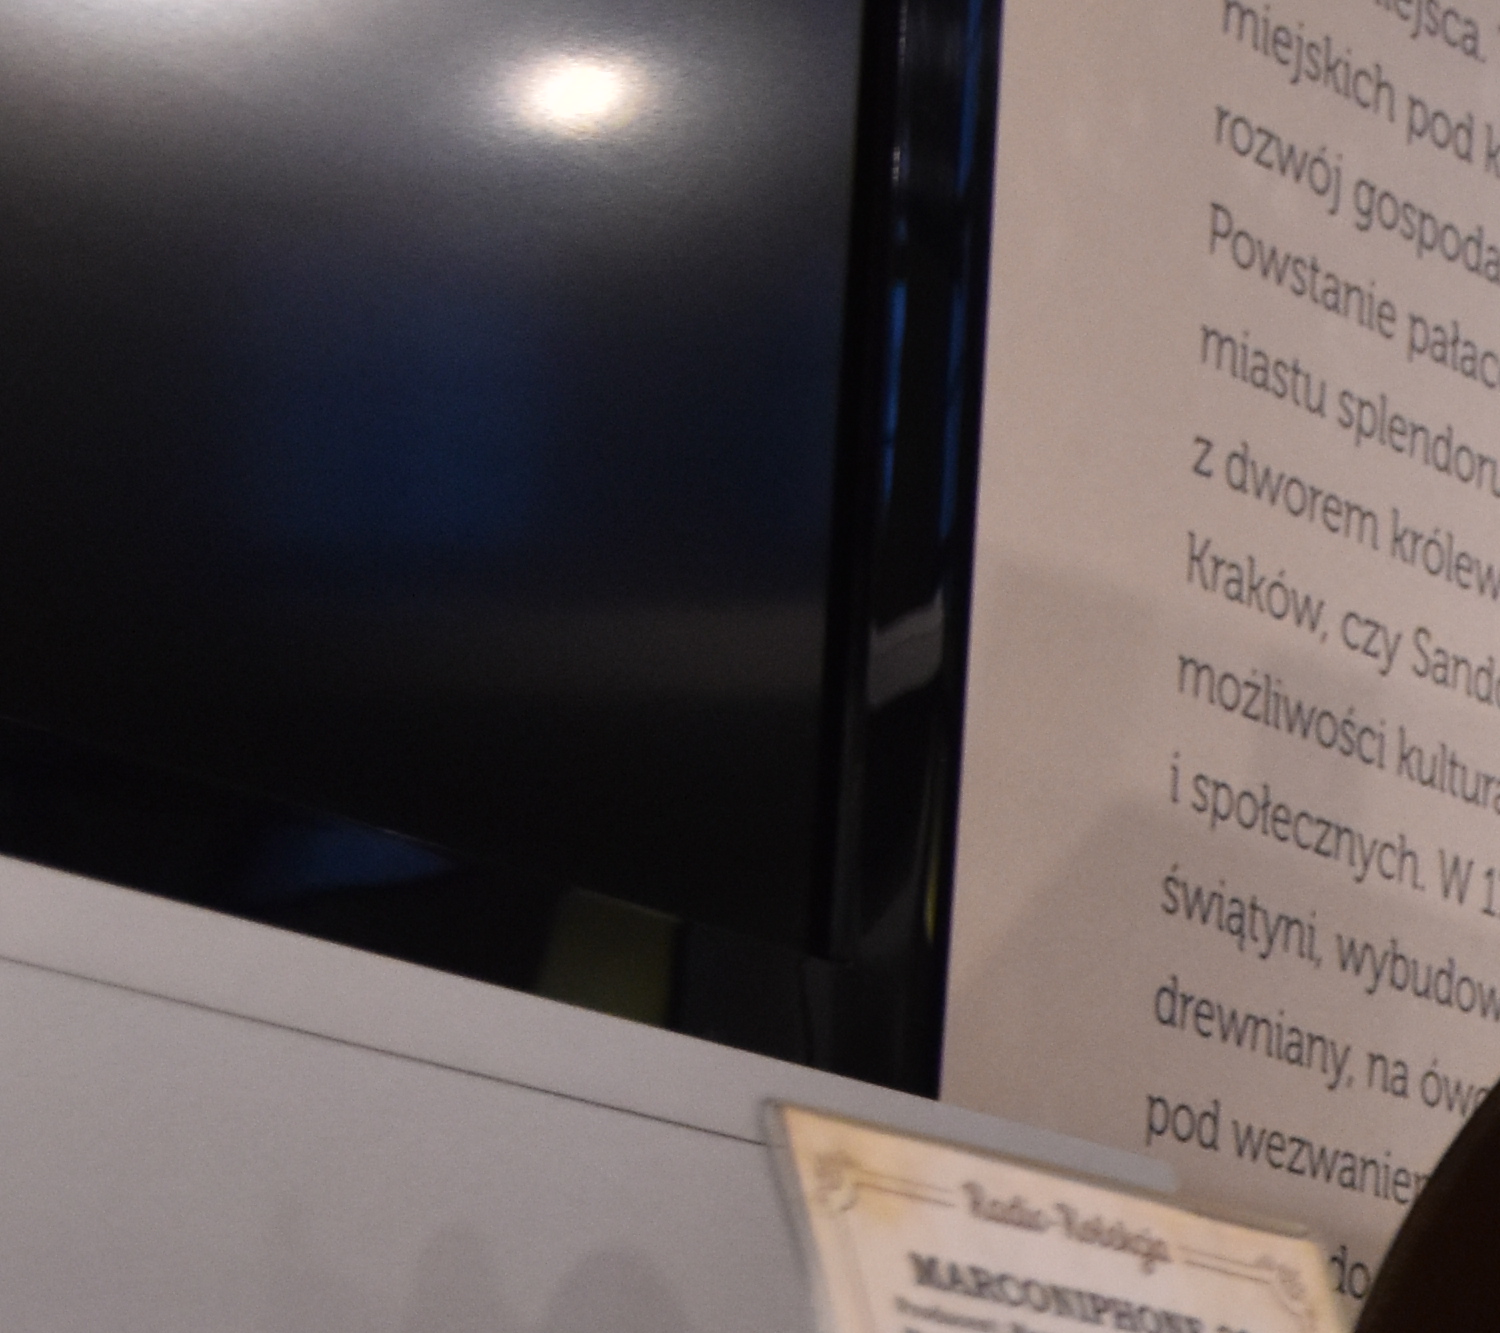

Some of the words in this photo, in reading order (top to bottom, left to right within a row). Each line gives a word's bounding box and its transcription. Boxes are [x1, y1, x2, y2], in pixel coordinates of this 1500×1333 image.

[1222, 0, 1396, 123] miejskich
[1406, 94, 1475, 165] pod
[1215, 105, 1342, 217] rozwój
[1209, 200, 1397, 341] Powstanie
[1200, 324, 1327, 419] miastu
[1191, 434, 1214, 480] z
[1224, 440, 1379, 551] dworem
[1187, 530, 1328, 642] Kraków,
[1340, 610, 1403, 678] czy
[1177, 653, 1385, 770] możliwości
[1169, 751, 1180, 805] i
[1191, 772, 1425, 891] społecznych.
[1438, 848, 1475, 906] W
[1161, 863, 1322, 968] świątyni,
[1153, 974, 1354, 1092] drewniany,
[1367, 1051, 1410, 1100] na
[1144, 1094, 1221, 1153] pod
